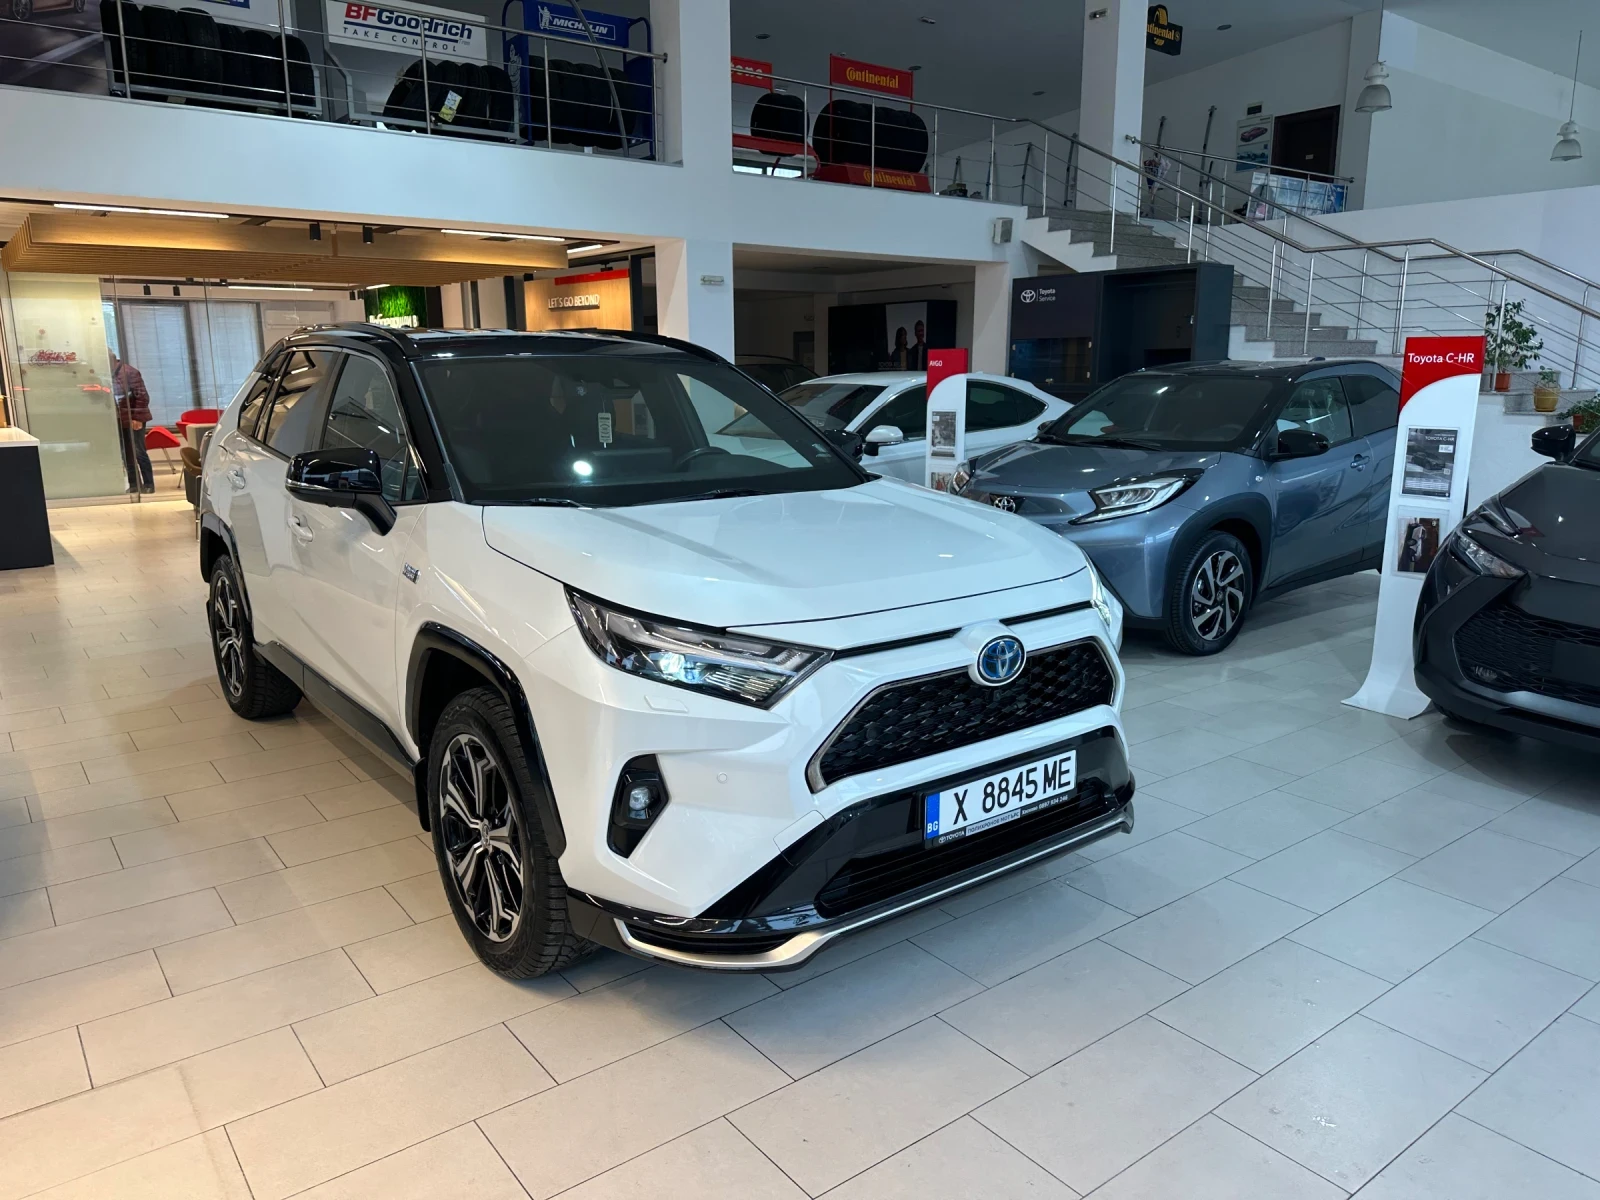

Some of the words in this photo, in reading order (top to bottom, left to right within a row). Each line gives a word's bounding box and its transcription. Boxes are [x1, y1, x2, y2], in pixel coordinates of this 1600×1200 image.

[344, 2, 472, 40] BFGoodrich
[552, 17, 608, 35] MICHLIN
[343, 27, 380, 39] TAKE
[391, 35, 457, 52] CONTROL
[731, 63, 763, 80] one
[846, 66, 899, 89] Continental
[563, 297, 573, 307] GO
[574, 294, 600, 306] BEYOND
[1407, 353, 1443, 366] Toyota
[1445, 353, 1475, 364] C-HR
[952, 789, 969, 825] X
[982, 766, 1038, 814] 8845
[1043, 756, 1072, 794] ME
[927, 820, 939, 833] BG
[946, 830, 965, 841] TOYOTA
